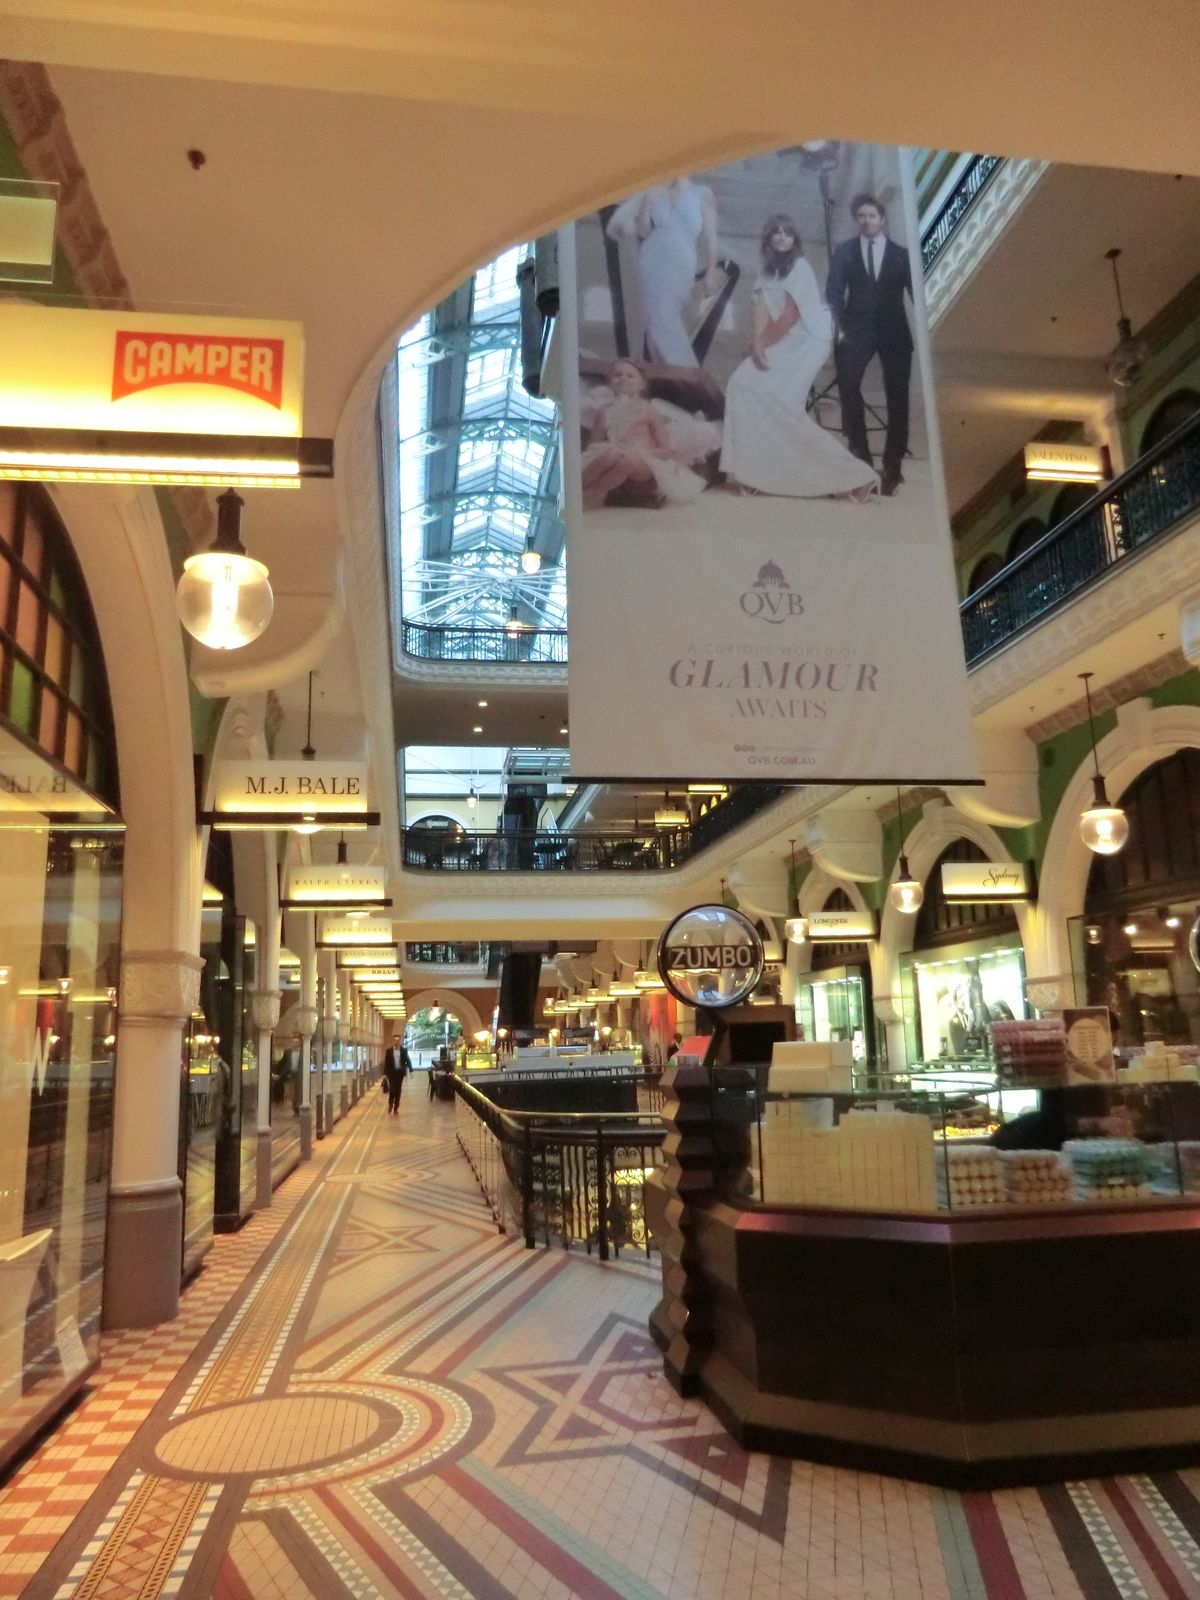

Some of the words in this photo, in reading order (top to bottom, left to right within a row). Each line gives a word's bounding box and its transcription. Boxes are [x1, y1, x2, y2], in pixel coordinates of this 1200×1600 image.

[123, 339, 274, 392] CAMPER
[1032, 449, 1088, 462] VALENTINO
[739, 591, 805, 625] QVB
[687, 643, 697, 654] A
[669, 658, 879, 692] GLAMOUR
[729, 697, 827, 719] AWAITS
[747, 756, 816, 766] QVB.COM.AU
[245, 776, 289, 795] M.J.
[296, 776, 361, 795] BALE
[982, 867, 1020, 888] Sydney
[671, 946, 752, 968] ZUMBO
